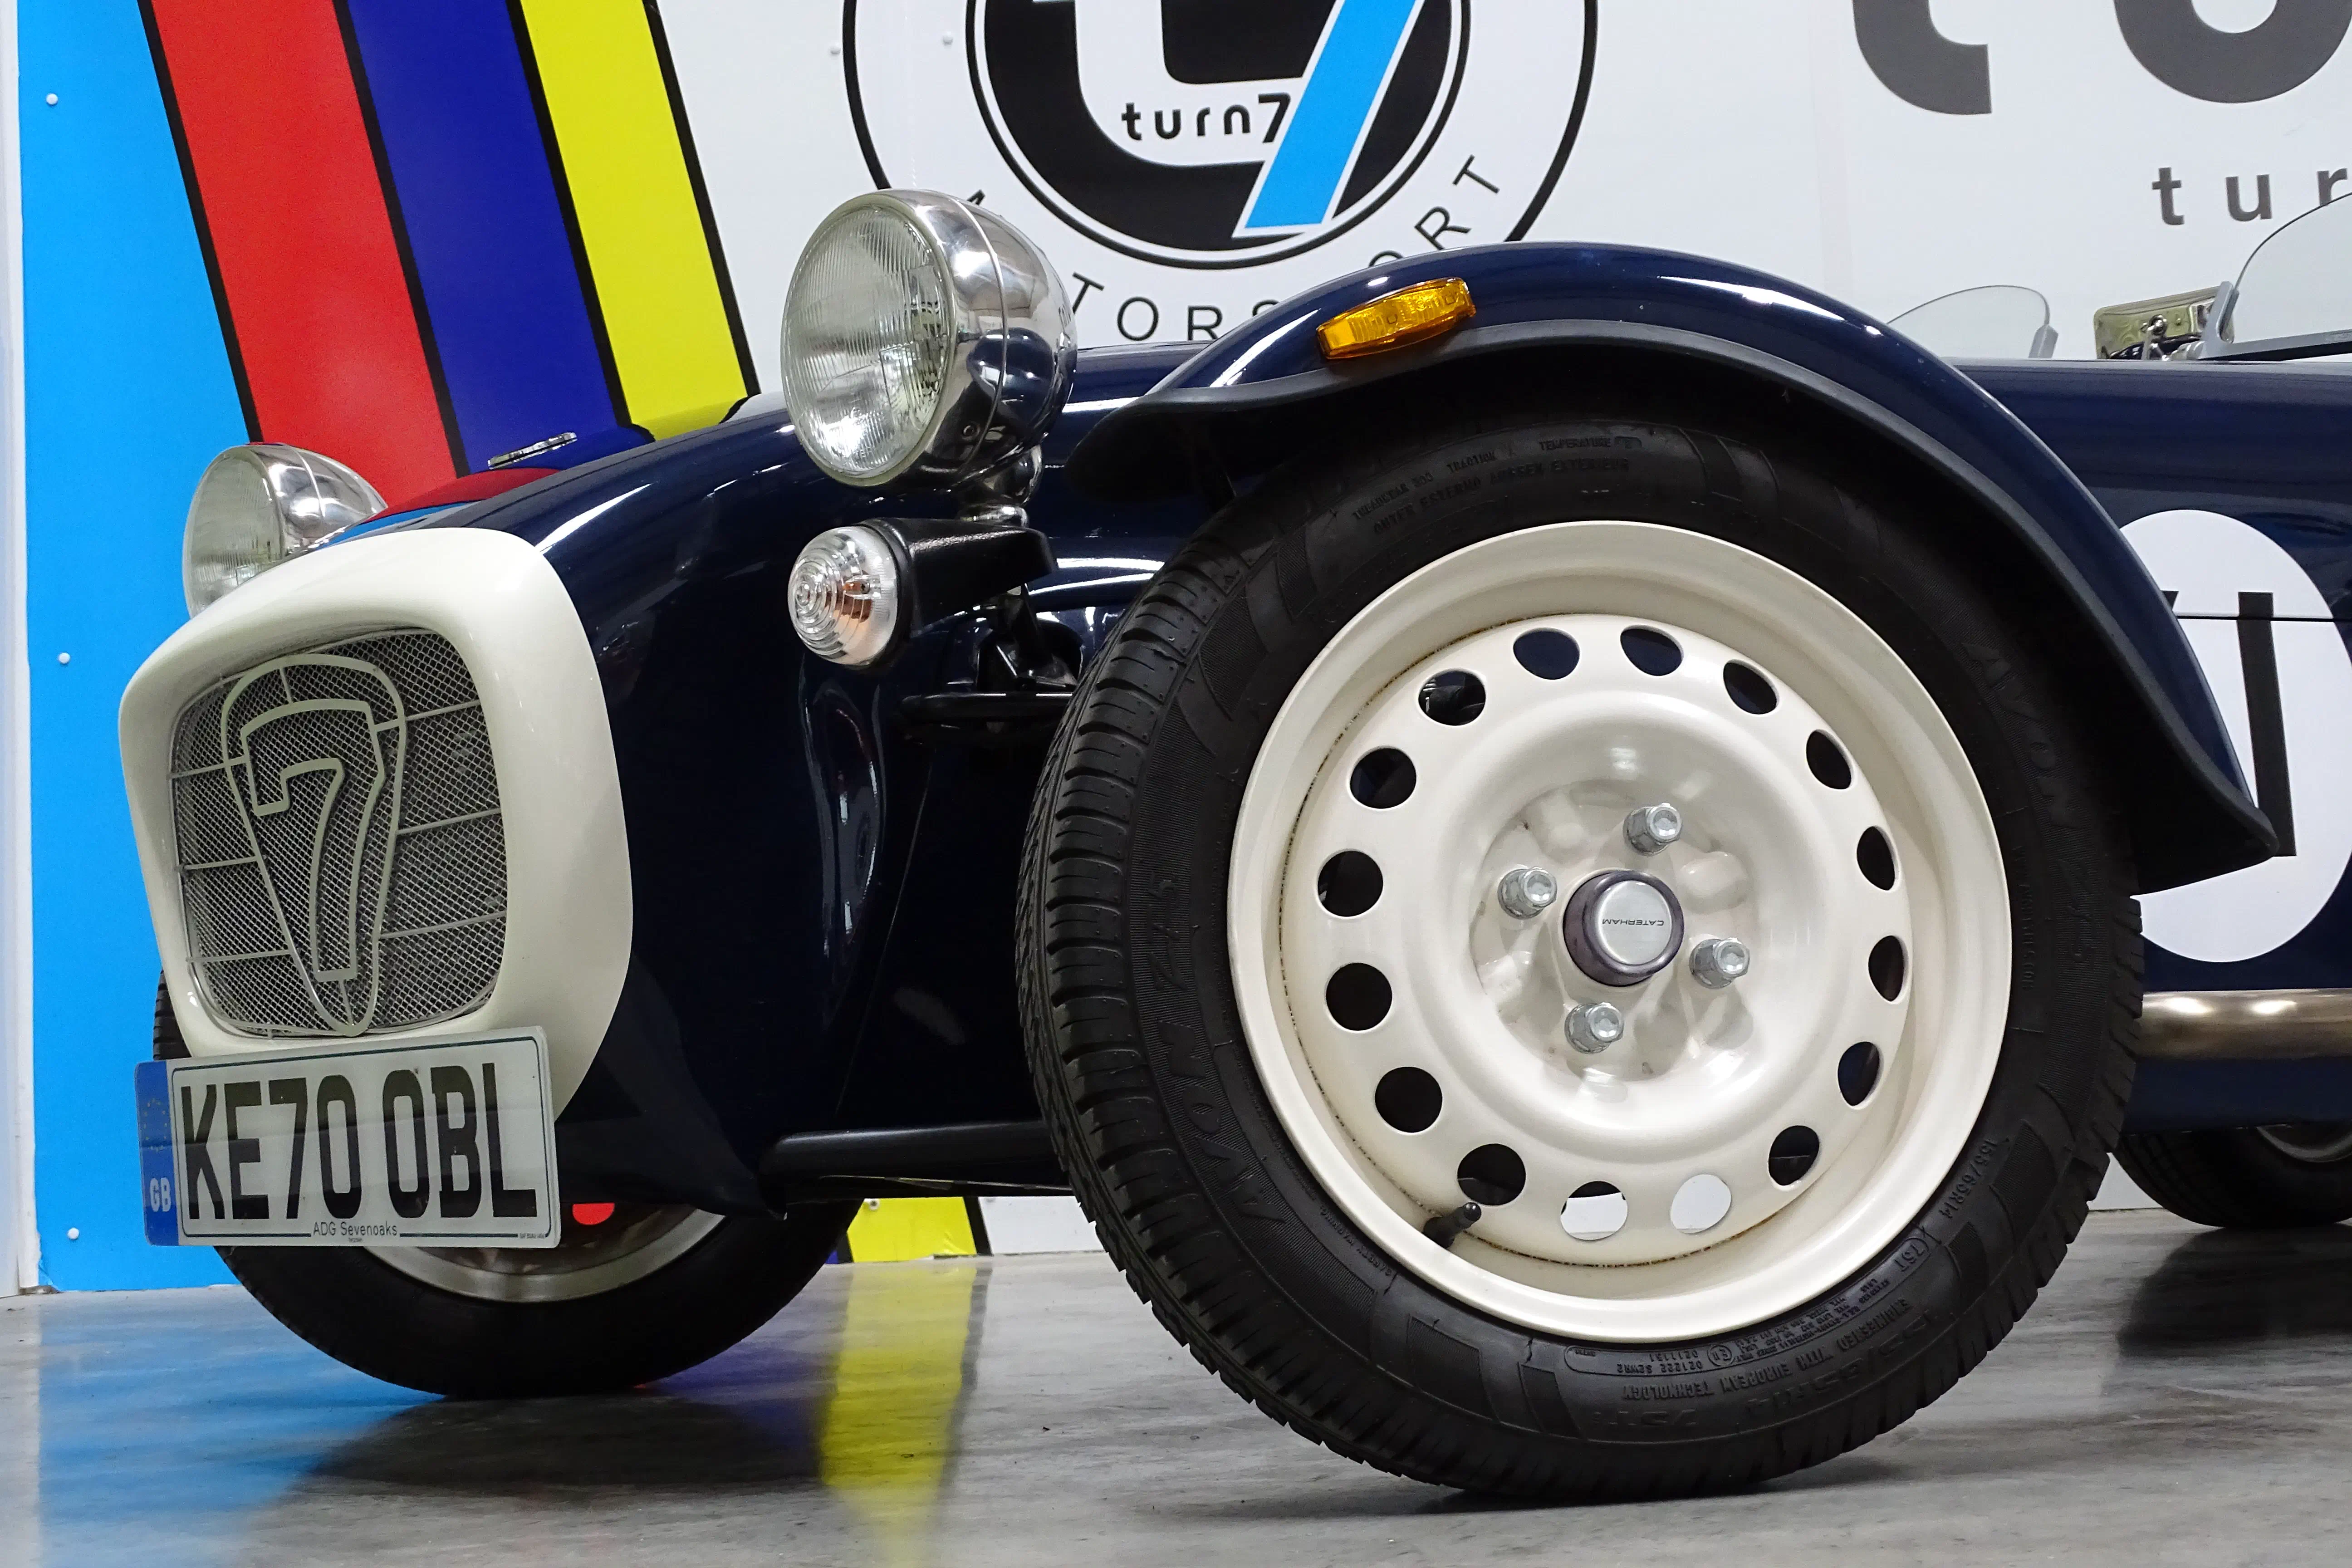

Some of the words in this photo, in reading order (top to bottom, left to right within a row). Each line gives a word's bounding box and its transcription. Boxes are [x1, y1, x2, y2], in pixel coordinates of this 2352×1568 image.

[1122, 92, 1291, 143] turn7
[181, 1073, 362, 1220] KE70
[382, 1062, 537, 1219] OBL
[1158, 1020, 1286, 1224] AVON
[150, 1176, 172, 1212] GB
[1937, 1136, 1999, 1222] 155/65R14
[313, 1221, 336, 1236] ADG
[340, 1221, 397, 1236] Sevenoaks
[1719, 1359, 1793, 1395] EUROPEAN
